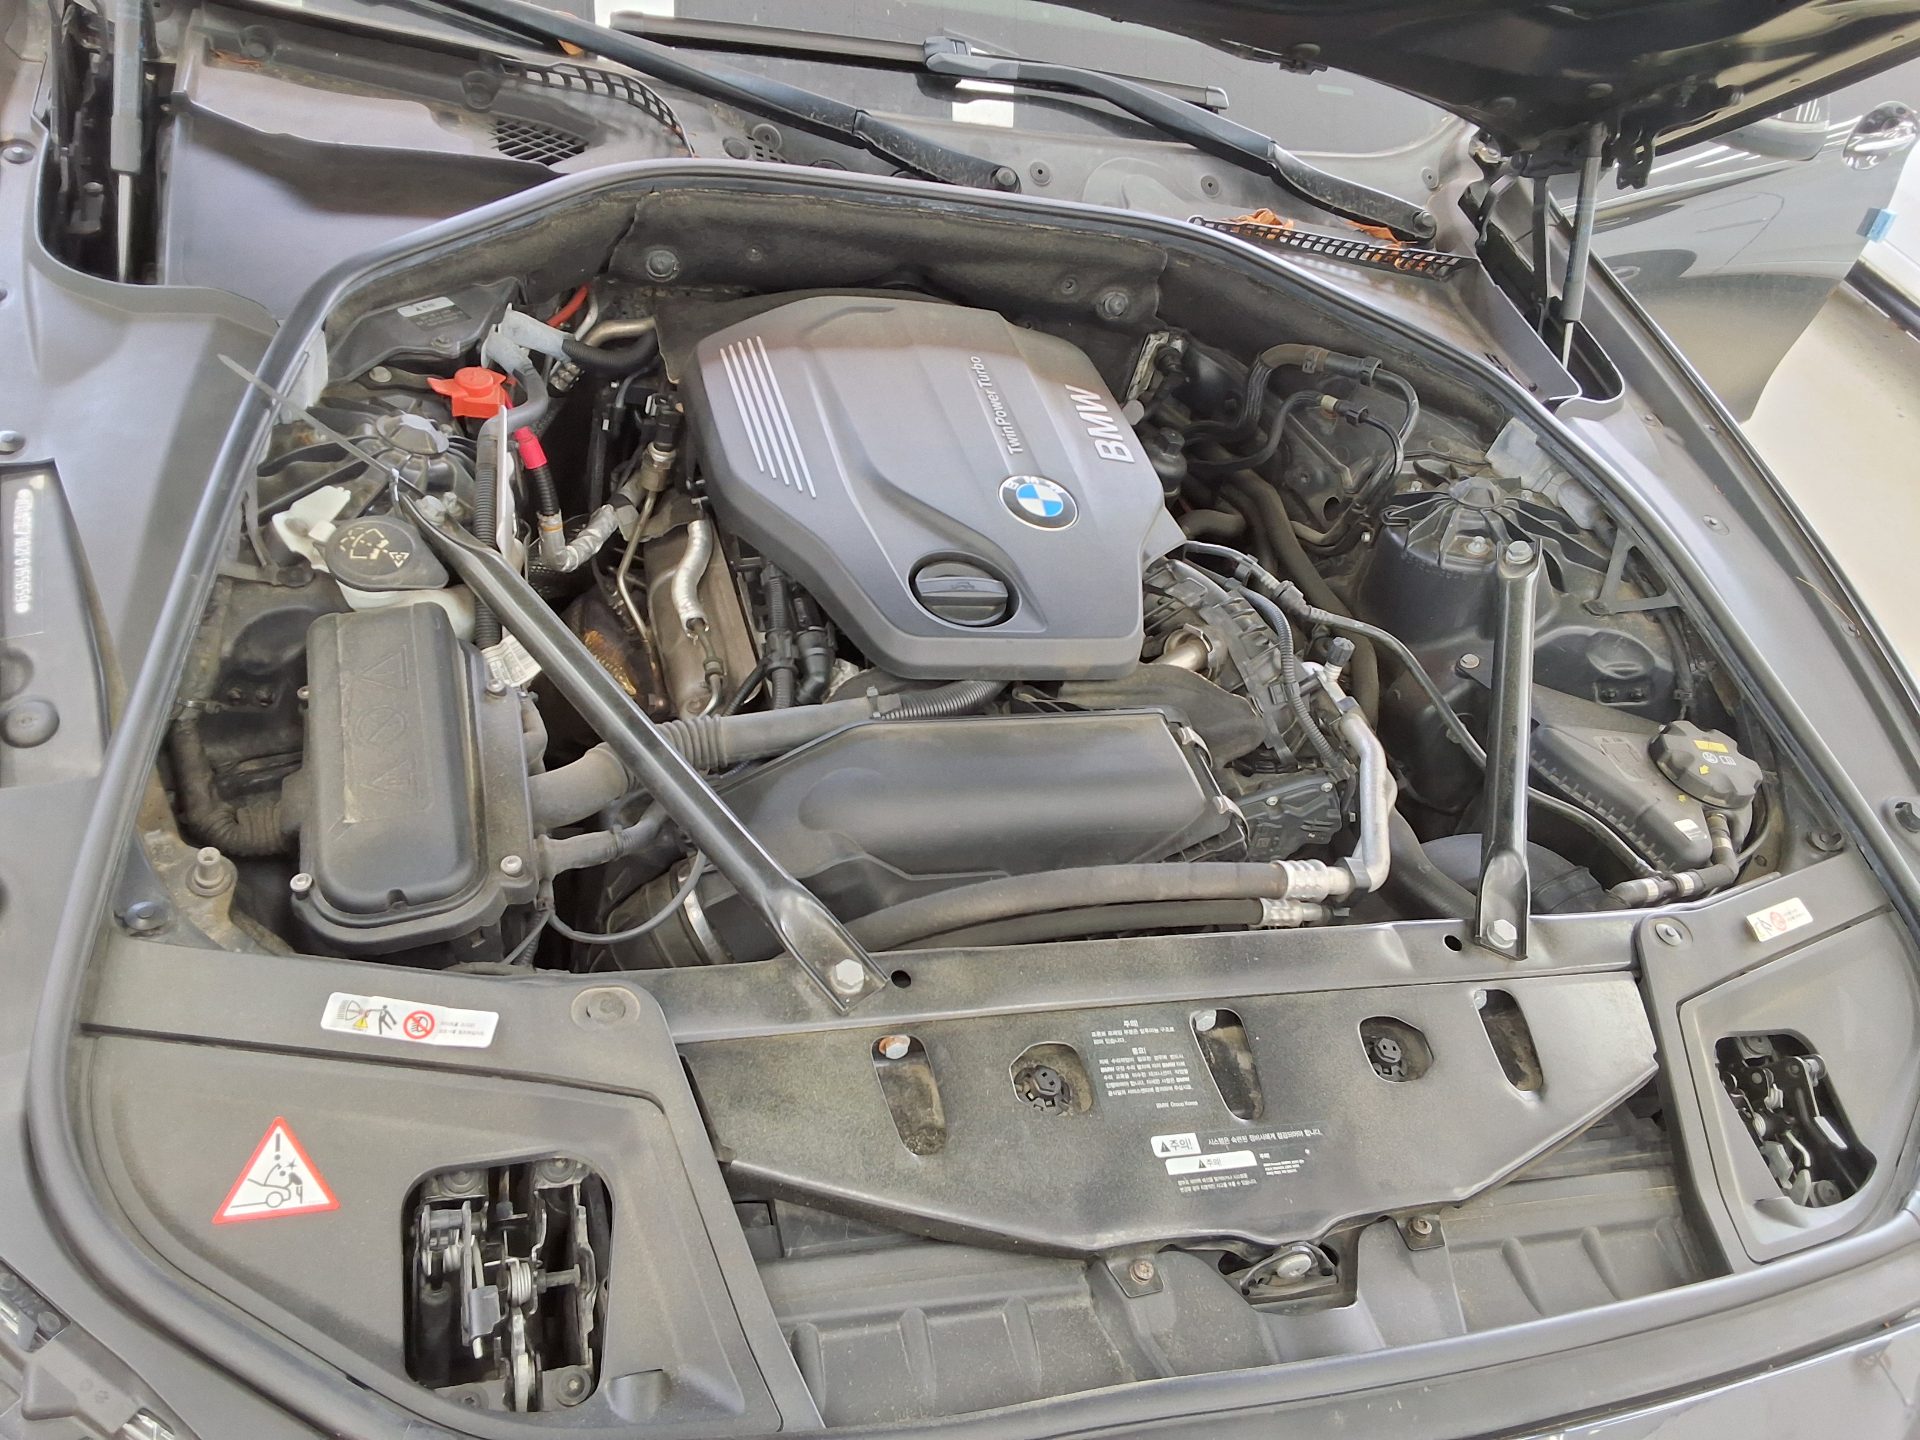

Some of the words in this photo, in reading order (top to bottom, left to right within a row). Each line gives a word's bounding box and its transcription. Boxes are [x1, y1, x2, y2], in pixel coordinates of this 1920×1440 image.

[970, 356, 993, 389] Turbo
[986, 389, 1024, 456] TwinPower
[1064, 384, 1136, 464] BMW
[1168, 1138, 1194, 1151] 주의!
